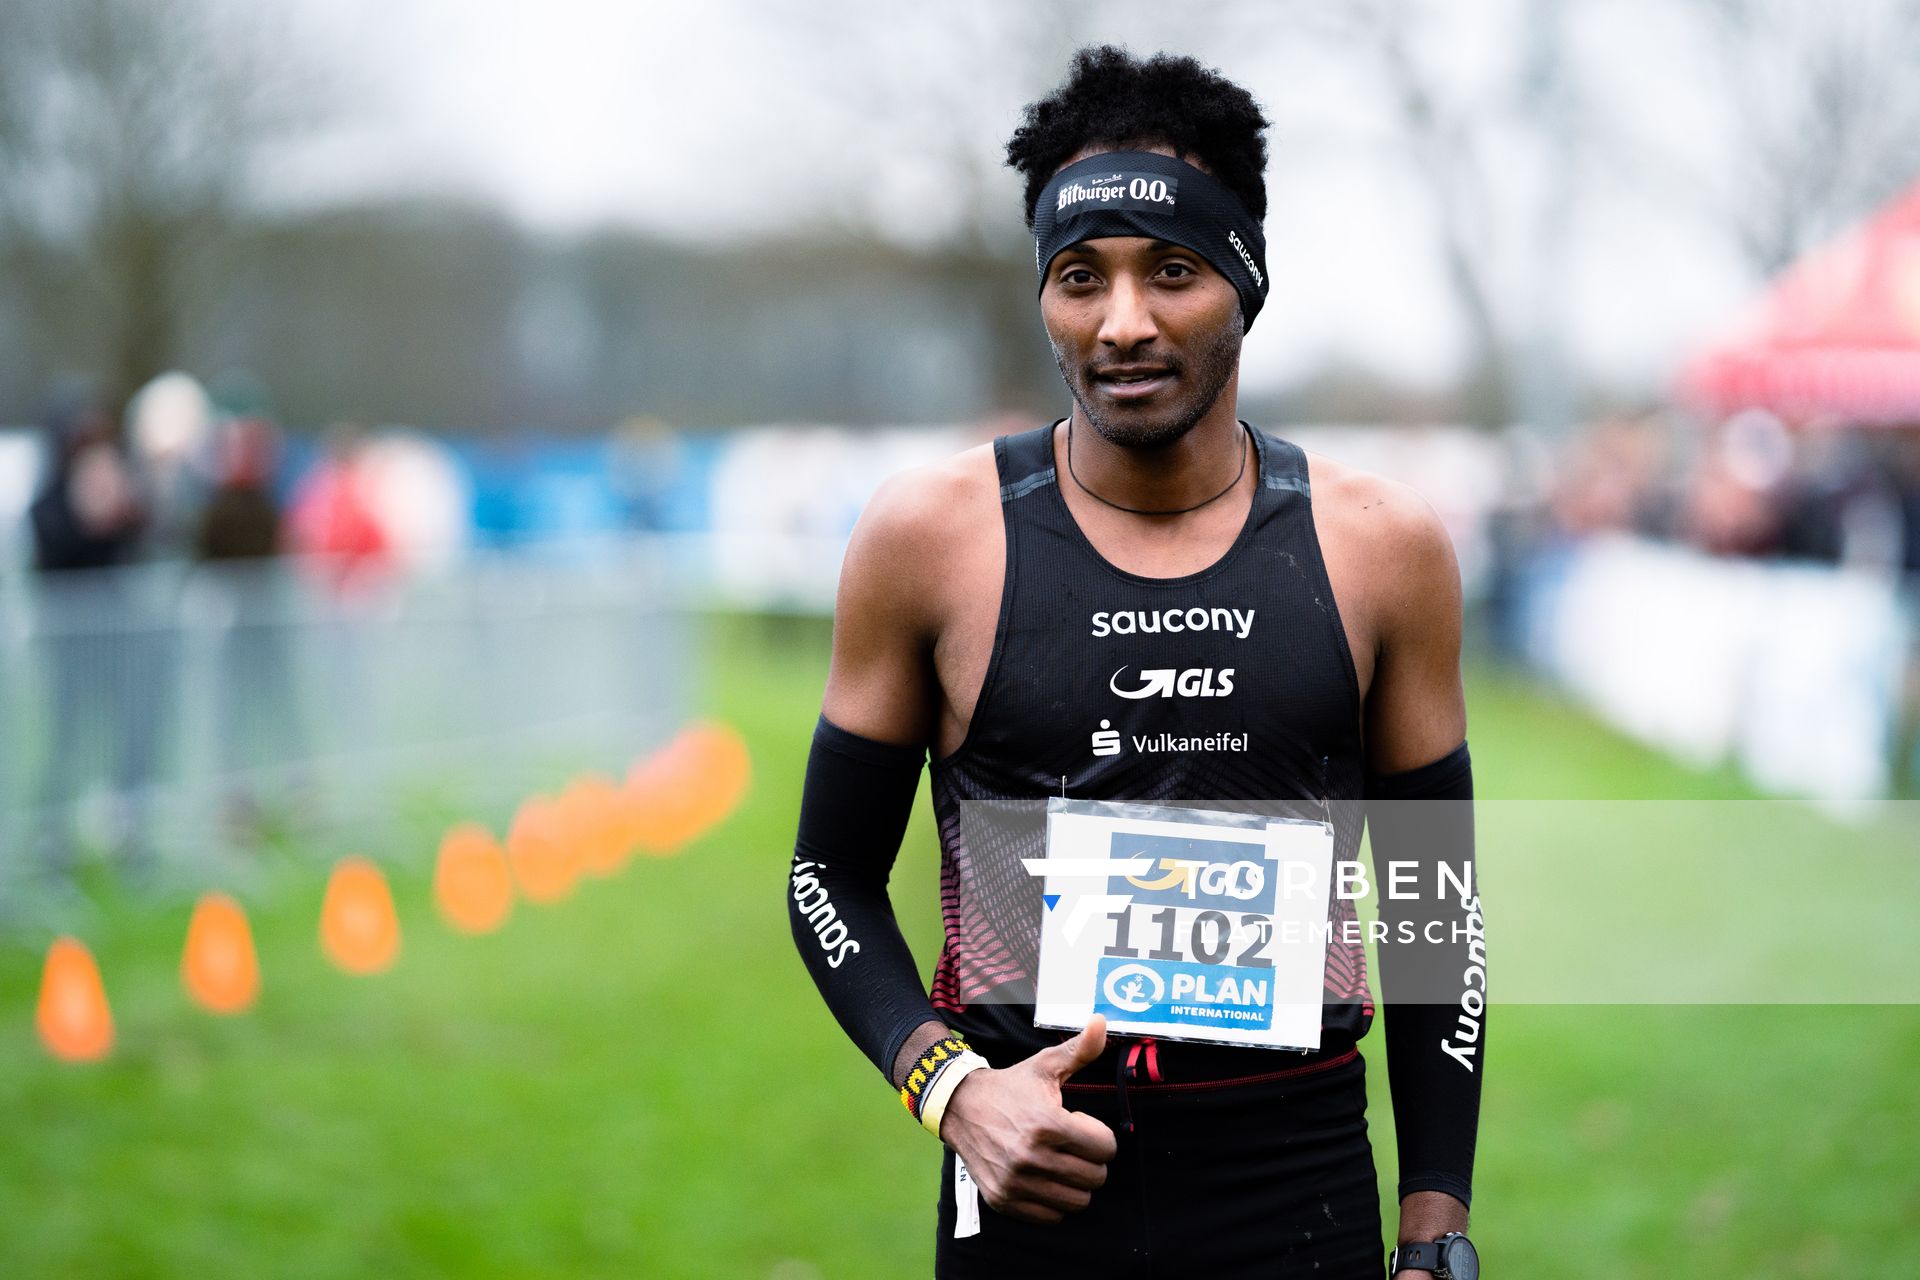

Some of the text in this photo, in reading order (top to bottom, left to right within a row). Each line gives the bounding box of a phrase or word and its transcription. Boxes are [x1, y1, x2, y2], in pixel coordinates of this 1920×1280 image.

[1057, 183, 1127, 211] Bitburger
[1228, 230, 1264, 287] saucony
[1091, 607, 1256, 639] saucony
[1176, 668, 1236, 698] GLS
[1132, 732, 1248, 753] Vulkaneifel
[1103, 904, 1274, 969] 1102
[1171, 973, 1268, 1007] PLAN
[1440, 895, 1486, 1073] saucony
[1170, 1005, 1265, 1022] INTERNATIONAL
